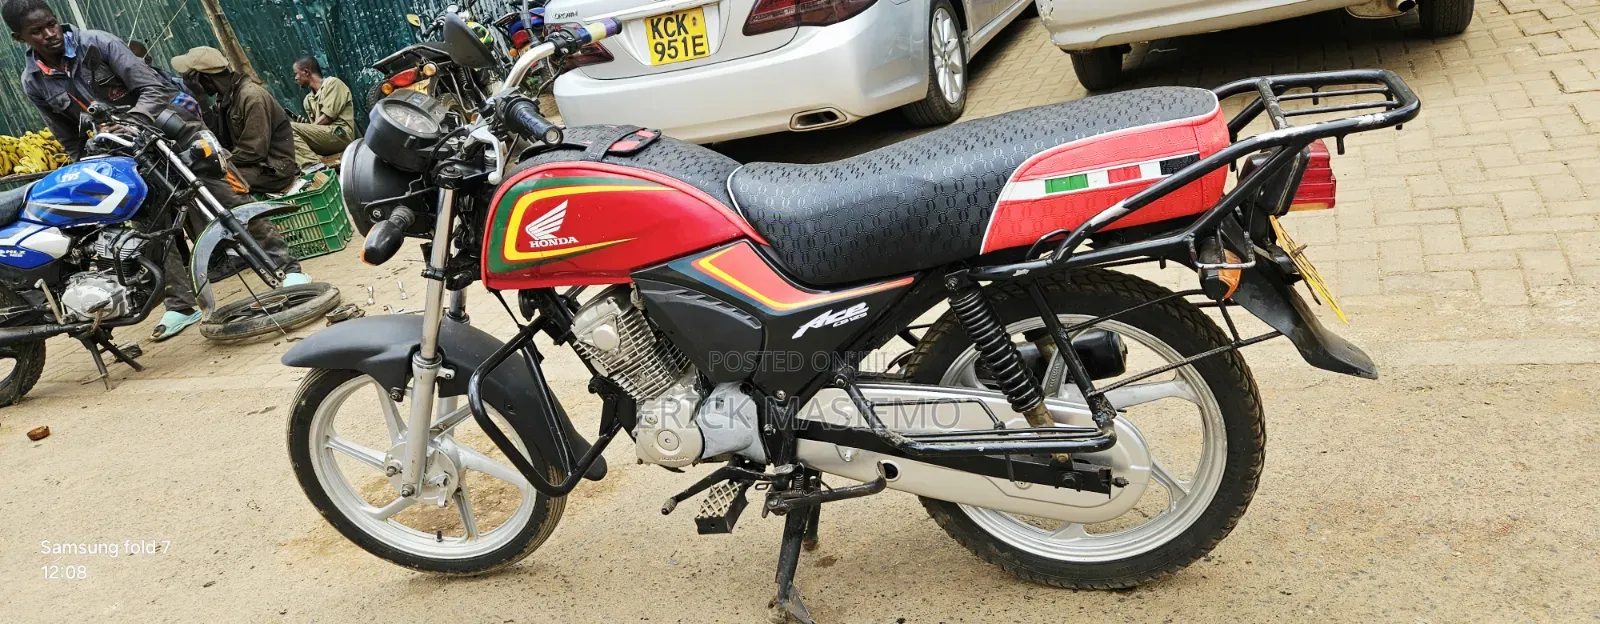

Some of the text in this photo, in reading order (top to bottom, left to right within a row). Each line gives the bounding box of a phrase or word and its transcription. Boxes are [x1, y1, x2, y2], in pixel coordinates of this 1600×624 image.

[651, 13, 689, 41] KCK
[653, 35, 706, 62] 951E
[529, 236, 579, 248] HONDA
